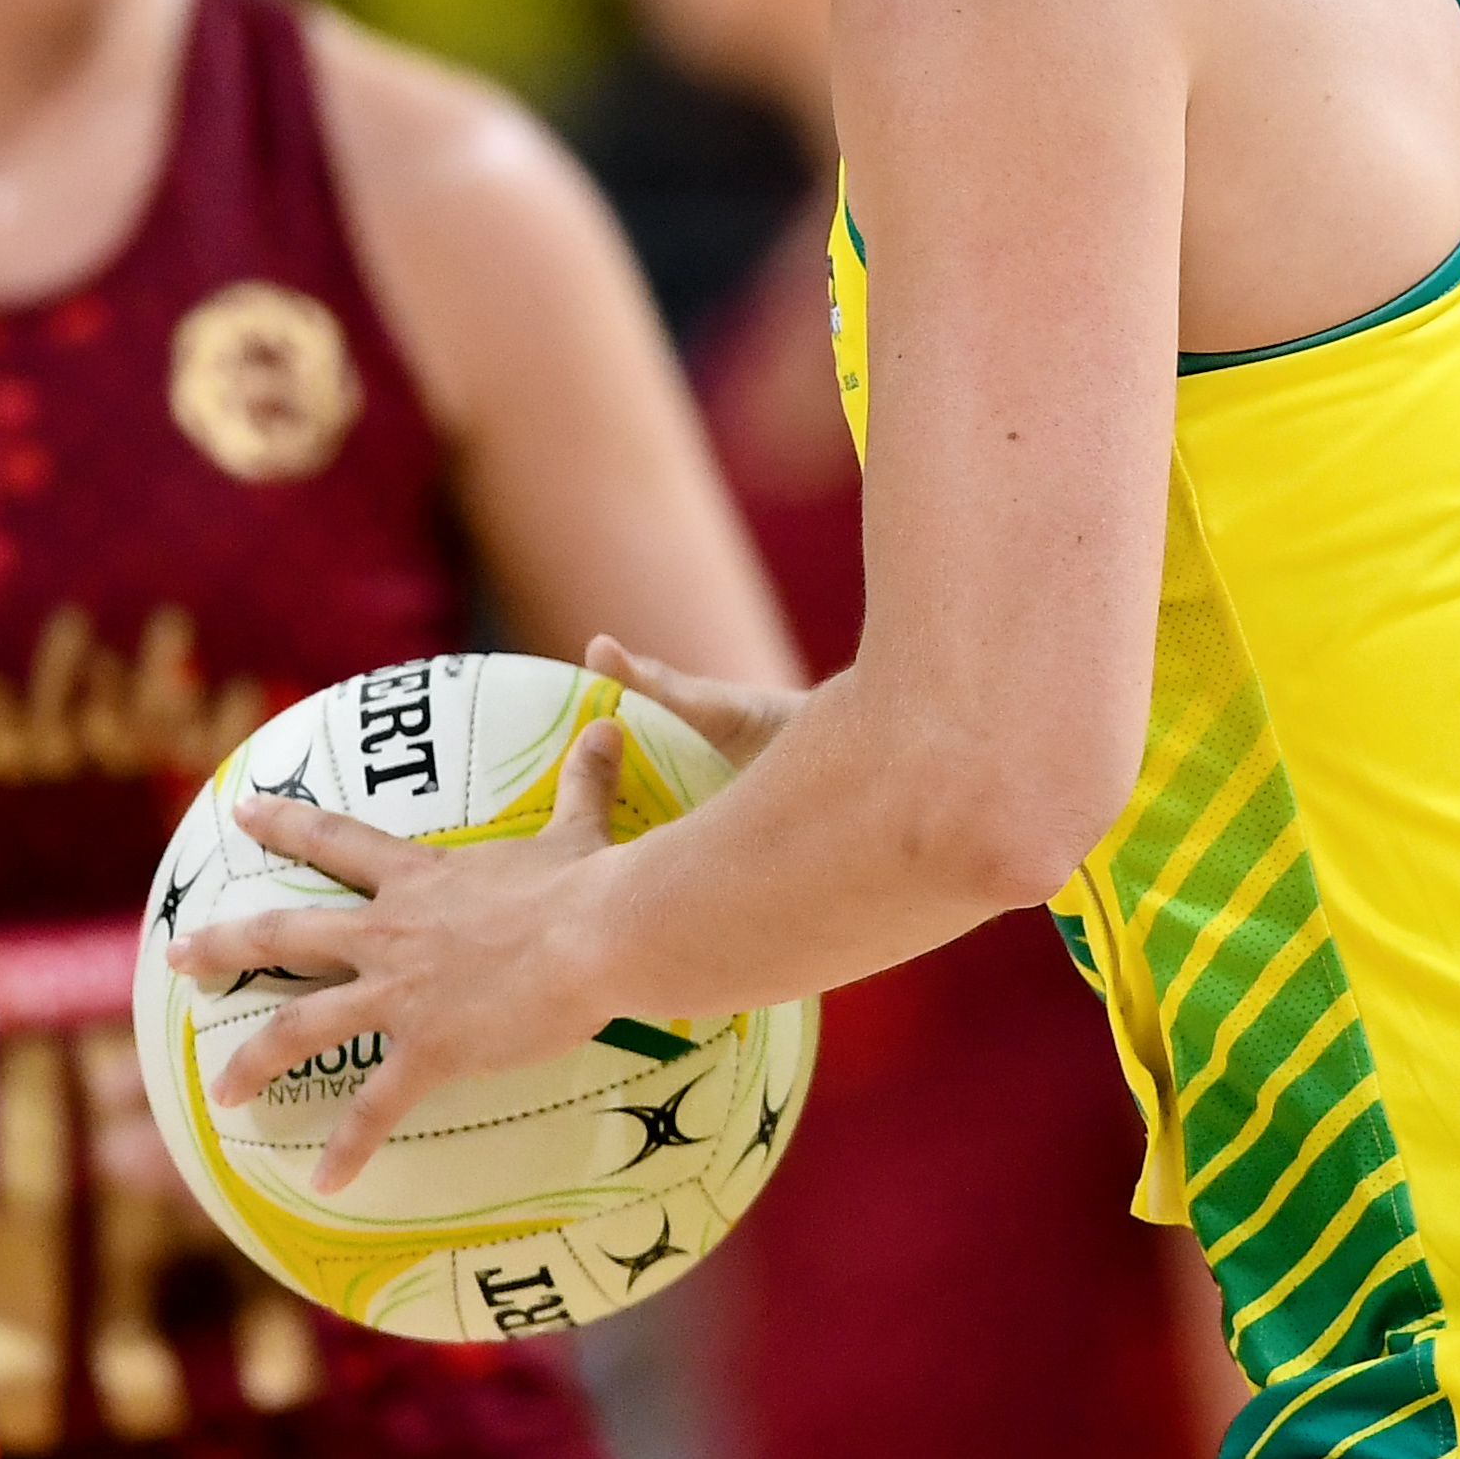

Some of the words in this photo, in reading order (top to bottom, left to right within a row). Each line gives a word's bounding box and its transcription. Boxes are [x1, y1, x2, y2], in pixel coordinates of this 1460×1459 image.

[361, 659, 439, 796] ERT
[268, 1071, 366, 1106] RALIAN
[474, 1265, 573, 1339] RT
